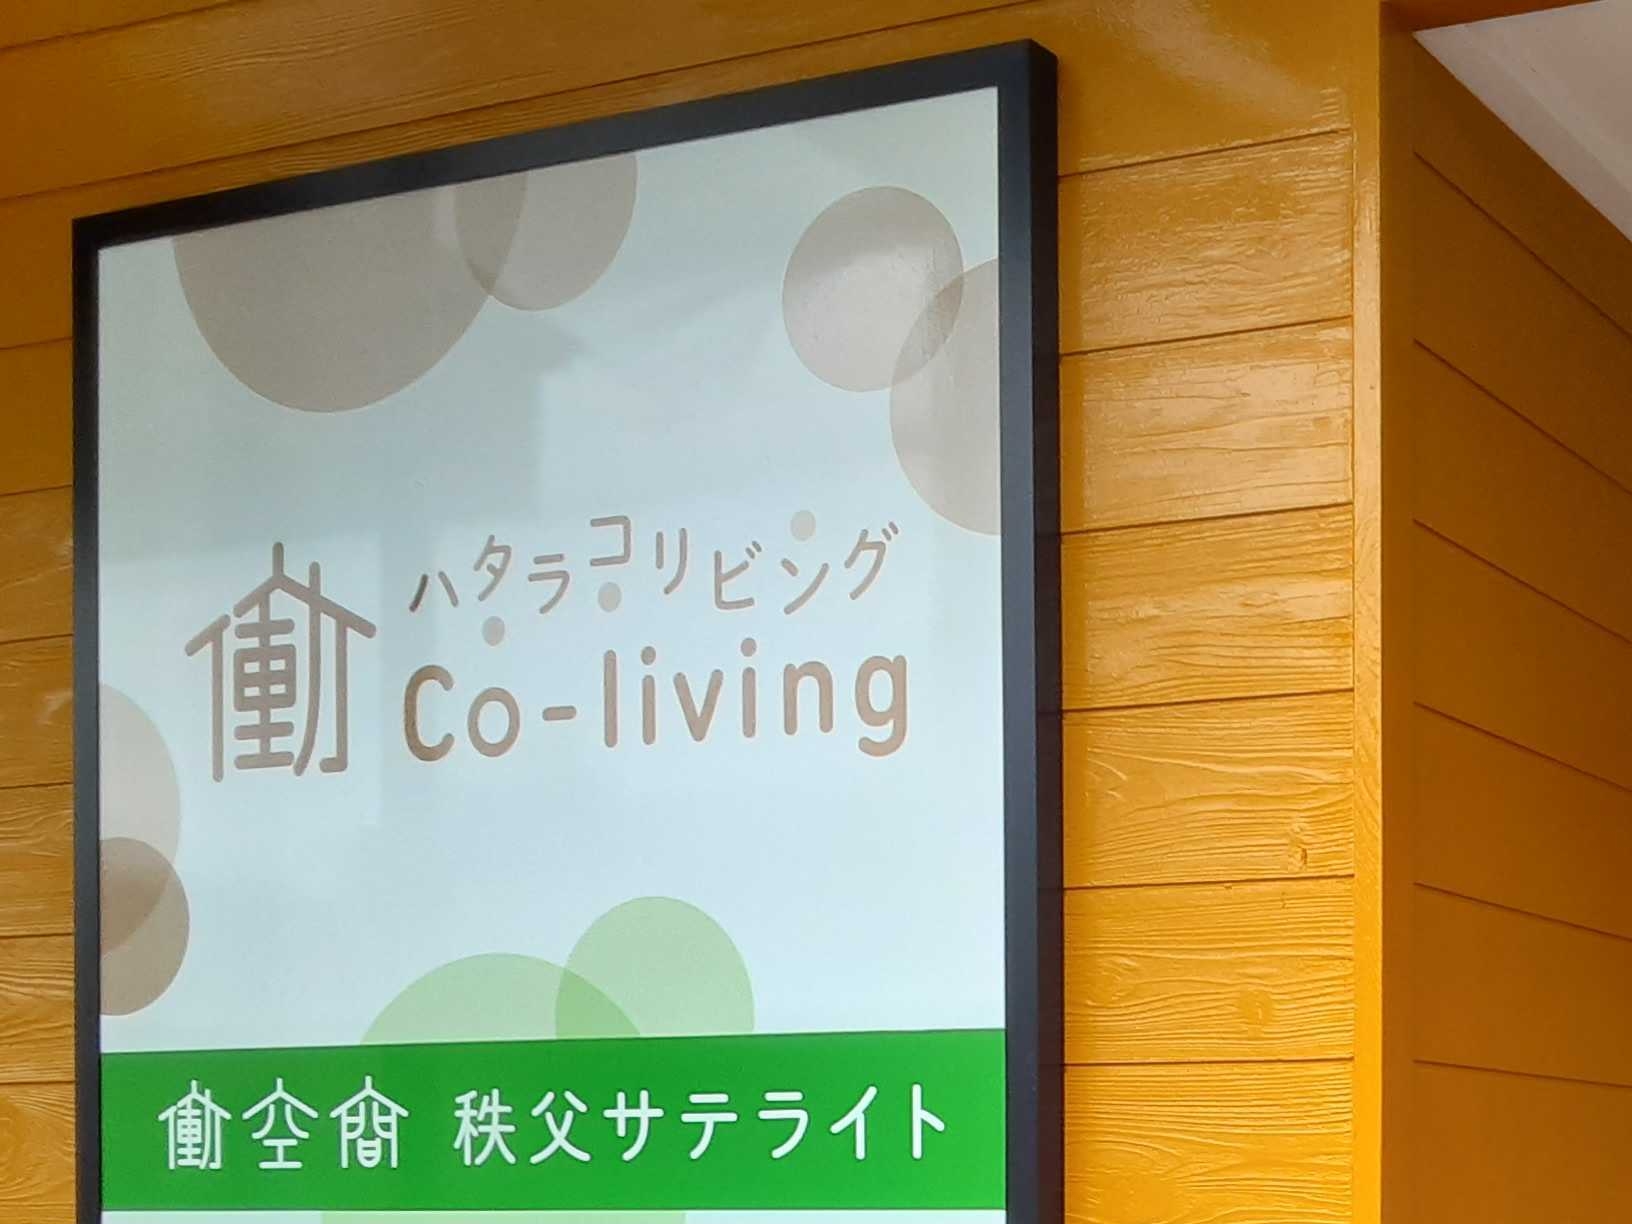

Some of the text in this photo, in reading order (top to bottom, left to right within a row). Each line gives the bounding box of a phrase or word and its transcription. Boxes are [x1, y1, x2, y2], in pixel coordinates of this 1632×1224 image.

[408, 514, 899, 616] ハタラコリビング
[403, 637, 908, 763] Co-living
[453, 1083, 946, 1168] 秩父サテライト
